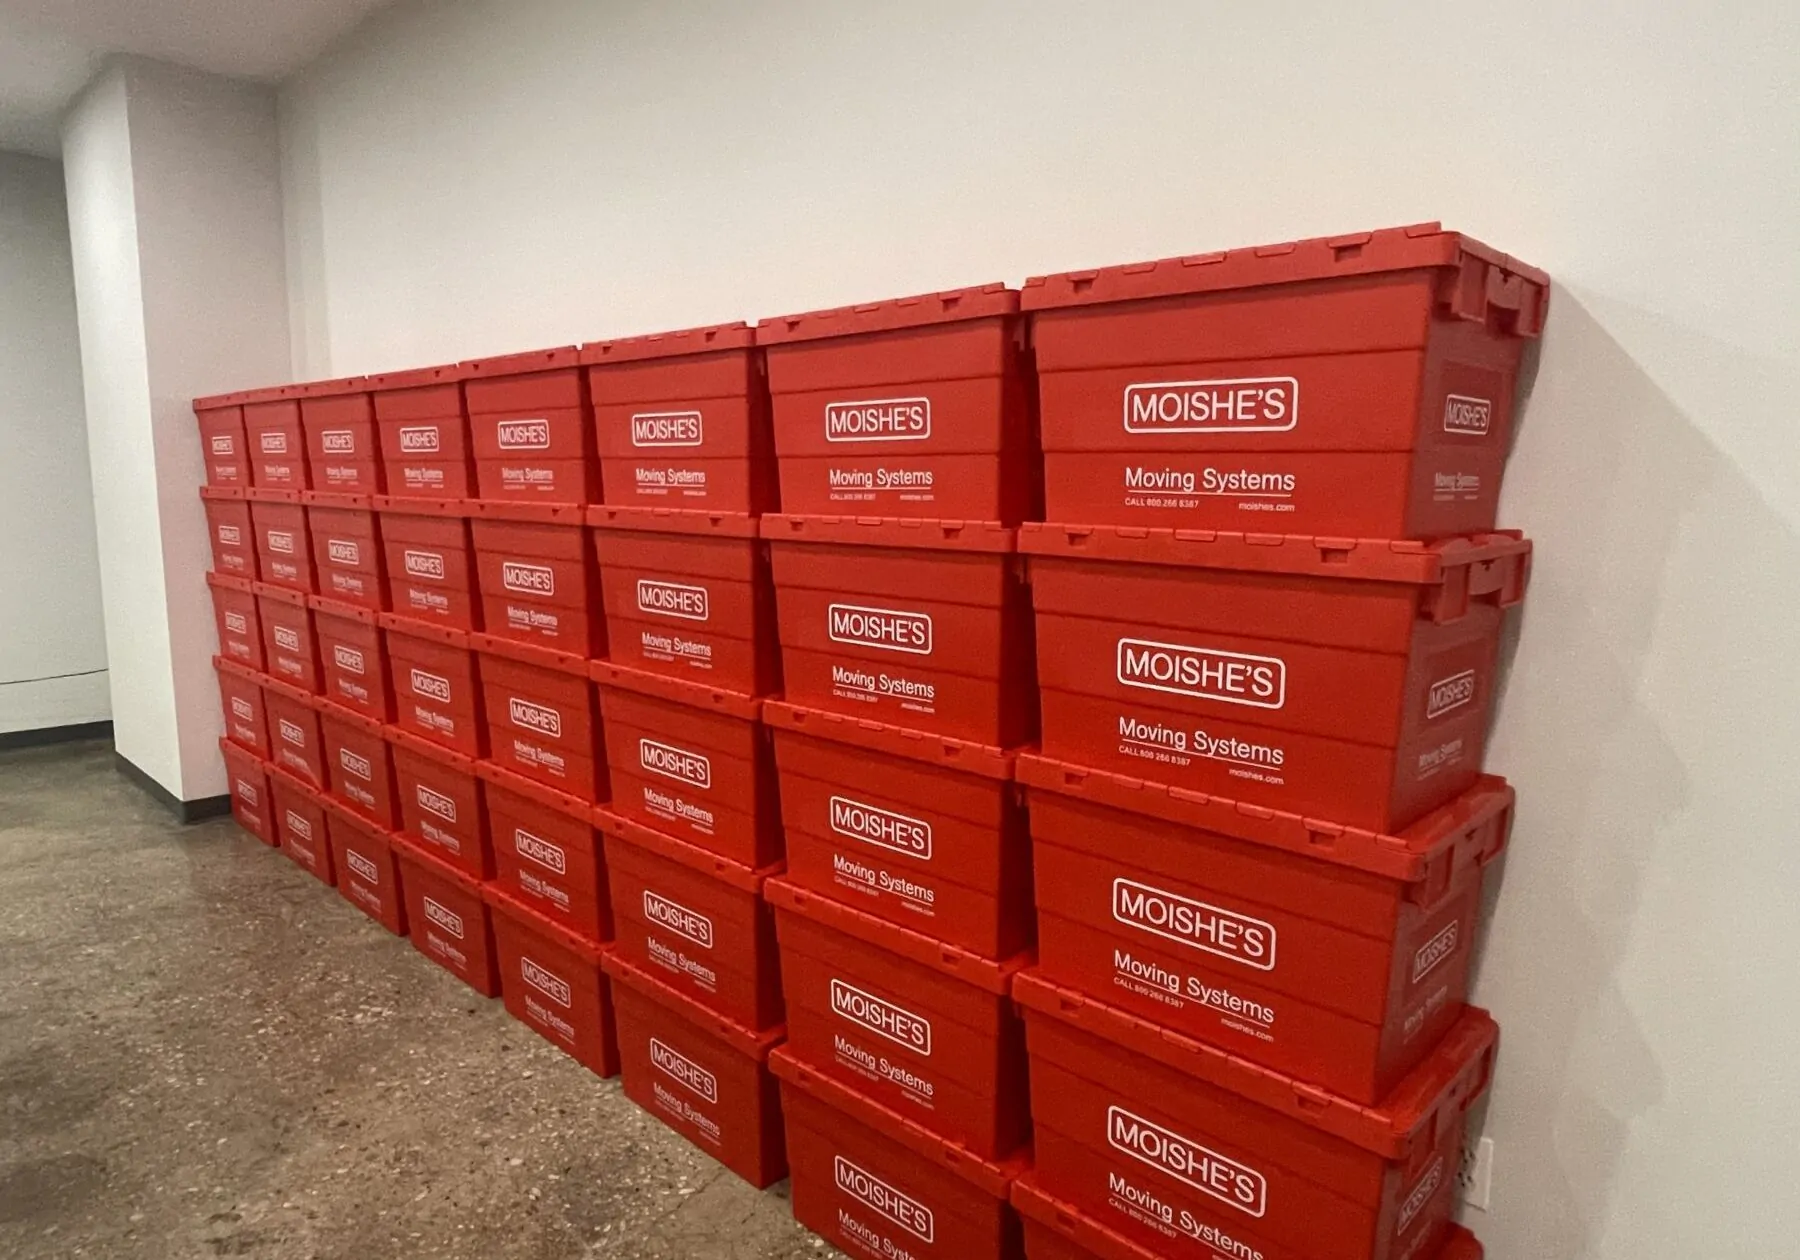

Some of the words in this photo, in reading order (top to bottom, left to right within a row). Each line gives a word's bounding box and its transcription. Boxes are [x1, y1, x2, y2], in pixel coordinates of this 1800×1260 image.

[831, 406, 923, 434] MOISHE'S
[1133, 389, 1285, 422] MOISHE'S
[1447, 401, 1487, 427] MOISHE'S
[501, 425, 546, 443] MOISHE'S
[636, 419, 698, 439] MOISHE'S
[636, 469, 665, 485] Moving
[667, 468, 705, 485] Systems
[829, 469, 872, 488] Moving
[877, 468, 933, 488] Systems
[1126, 468, 1195, 493] Moving
[1203, 468, 1295, 493] Systems
[1125, 497, 1146, 507] CALL
[1147, 498, 1162, 508] 800
[1162, 499, 1178, 508] 266
[1179, 500, 1199, 509] 8387
[1239, 502, 1295, 512] moishes.com
[506, 568, 550, 589] MOISHE'S
[641, 587, 703, 613] MOISHE'S
[642, 632, 671, 651] Moving
[674, 638, 711, 657] Systems
[834, 612, 925, 645] MOISHE'S
[832, 666, 875, 691] Moving
[879, 675, 934, 699] Systems
[1126, 649, 1273, 697] MOISHE'S
[513, 704, 557, 731] MOISHE'S
[1119, 716, 1186, 750] Moving
[1194, 731, 1284, 766] Systems
[1119, 744, 1139, 757] CALL
[644, 746, 706, 781] MOISHE'S
[1229, 769, 1284, 786] moishes.com
[644, 788, 674, 811] Moving
[676, 800, 713, 824] Systems
[835, 805, 925, 851] MOISHE'S
[518, 835, 562, 869] MOISHE'S
[834, 854, 875, 885] Moving
[879, 871, 934, 903] Systems
[647, 897, 708, 941] MOISHE'S
[1121, 889, 1264, 959] MOISHE'S
[648, 937, 676, 964] Moving
[678, 954, 715, 982] Systems
[524, 962, 567, 1002] MOISHE'S
[1114, 976, 1134, 991] CALL
[1115, 950, 1180, 993] Moving
[1187, 977, 1274, 1025] Systems
[836, 987, 924, 1047] MOISHE'S
[653, 1044, 712, 1097] MOISHE'S
[834, 1035, 876, 1070] Moving
[879, 1058, 933, 1097] Systems
[1116, 1116, 1254, 1206] MOISHE'S
[840, 1164, 927, 1235] MOISHE'S
[1110, 1173, 1173, 1224] Moving
[839, 1209, 879, 1249] Moving
